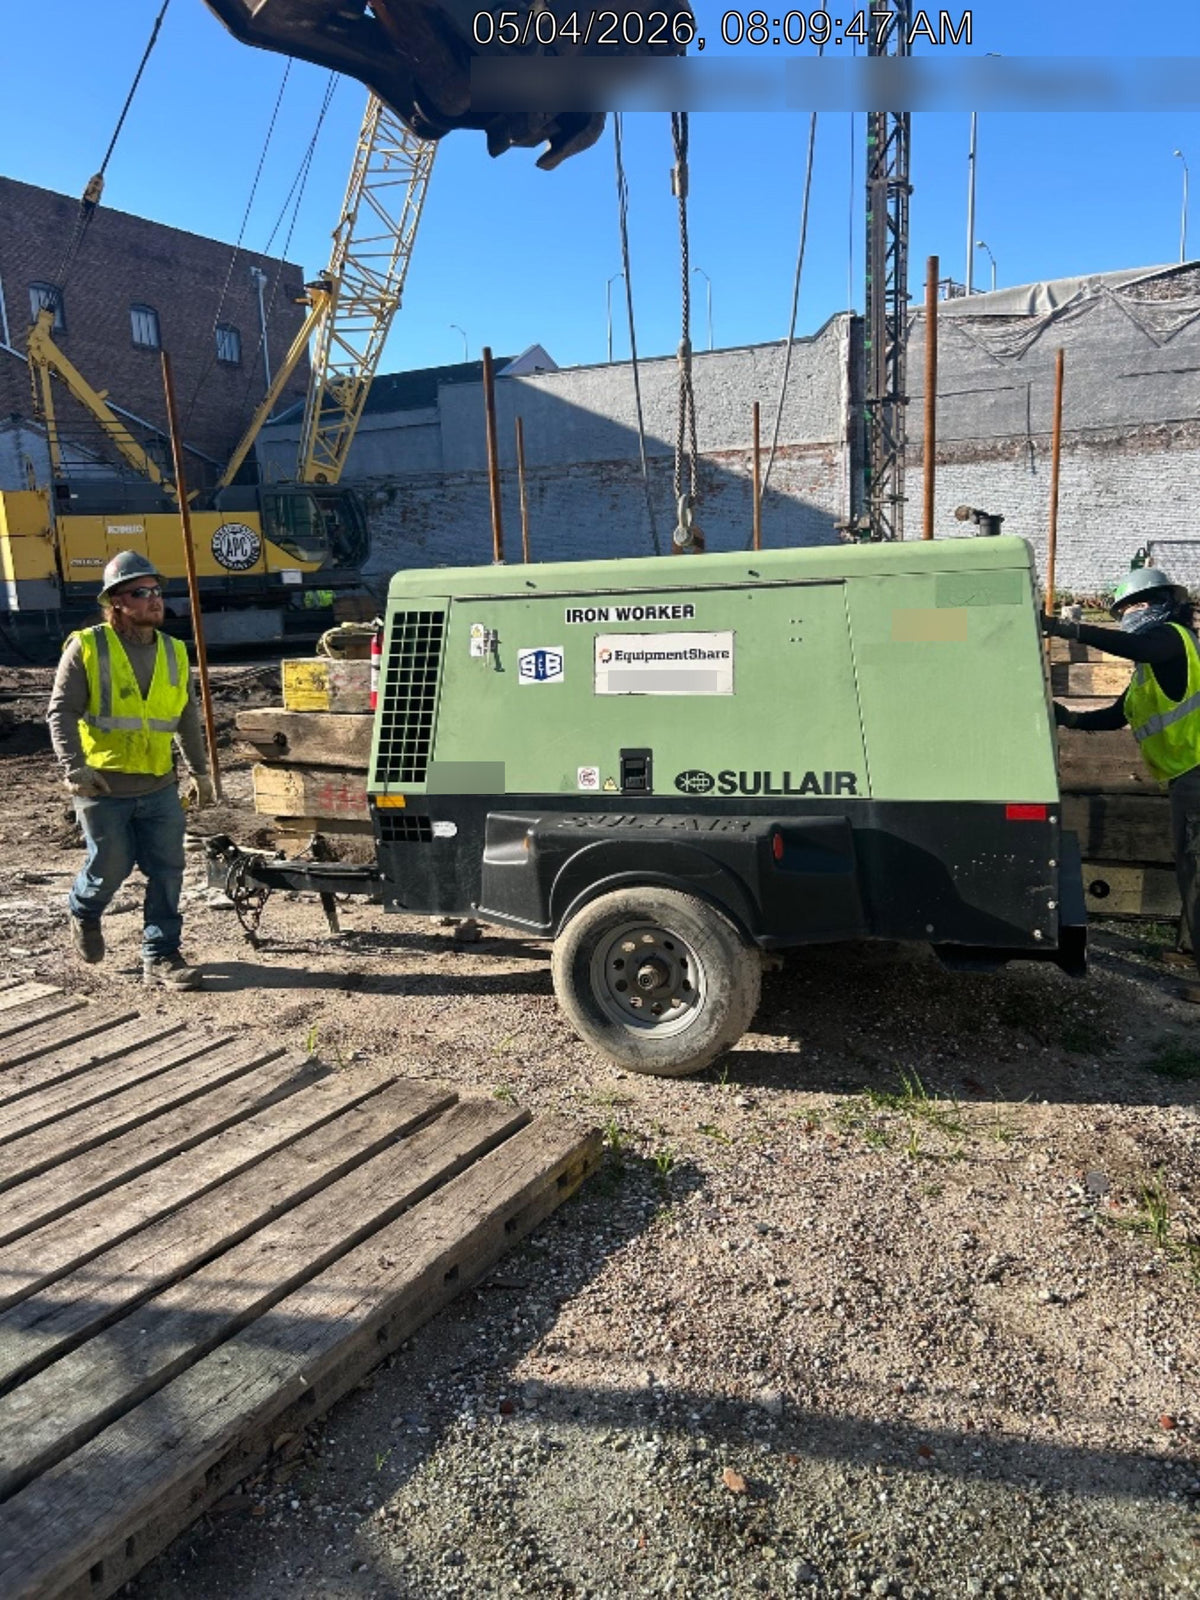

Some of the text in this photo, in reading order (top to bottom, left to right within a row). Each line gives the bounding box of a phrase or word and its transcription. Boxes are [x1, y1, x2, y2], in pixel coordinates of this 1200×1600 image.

[227, 536, 248, 557] APC
[566, 604, 695, 623] IRON WORKER
[614, 648, 730, 664] EquipmentShare
[717, 769, 858, 796] SULLAIR
